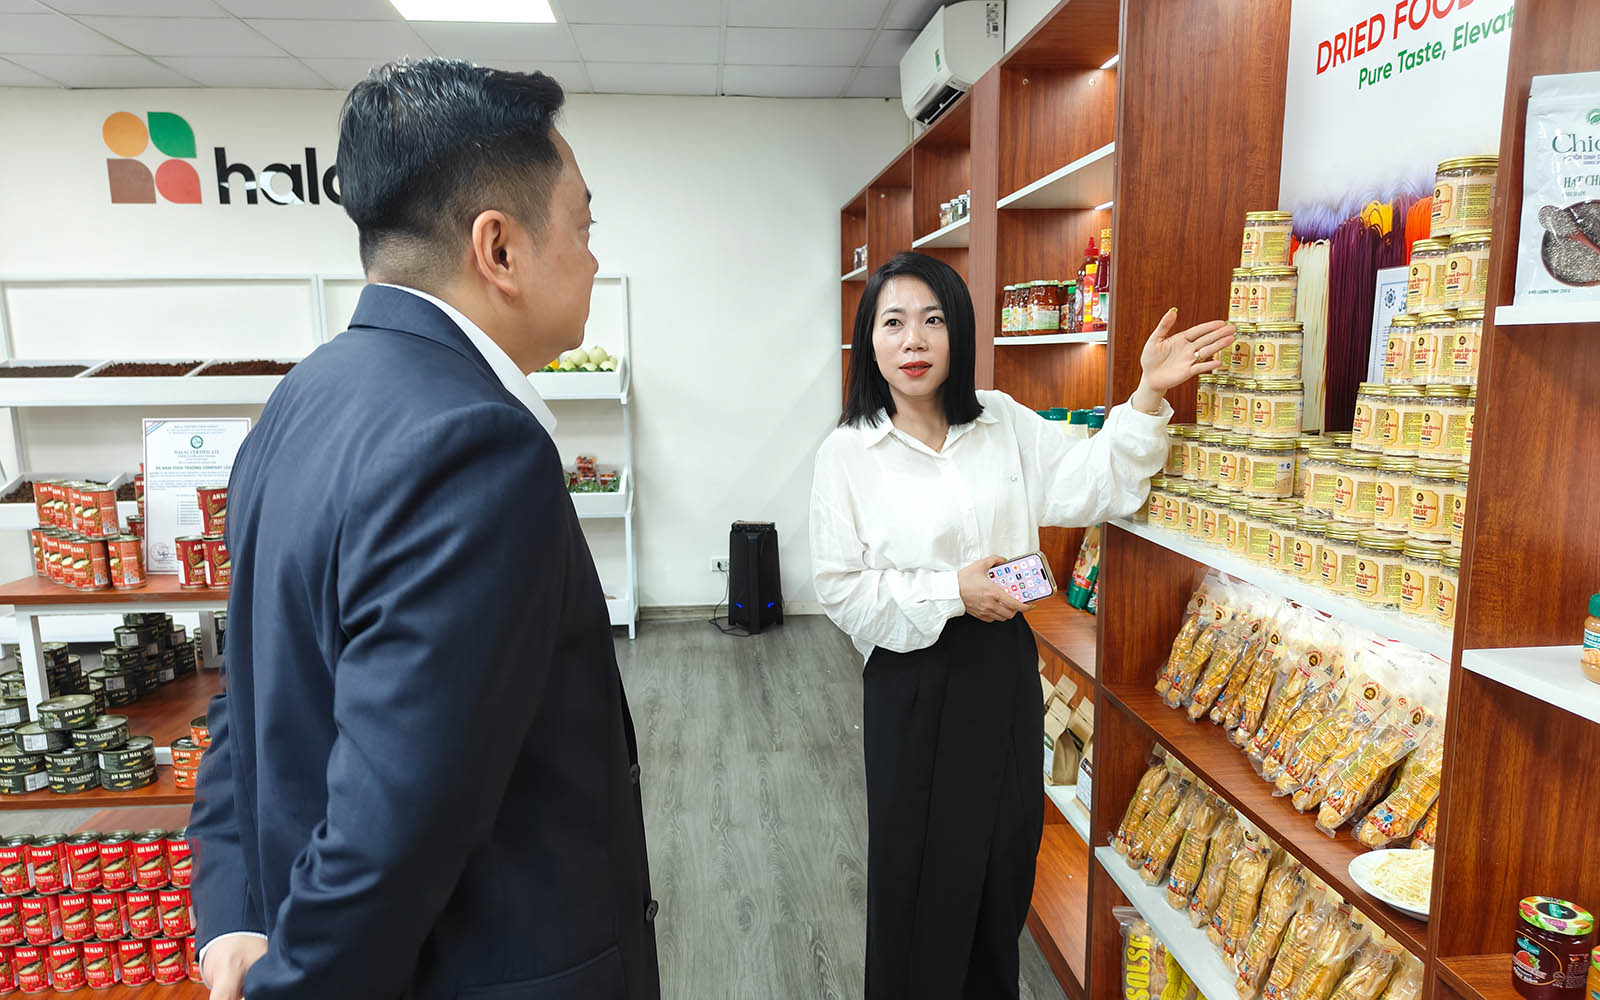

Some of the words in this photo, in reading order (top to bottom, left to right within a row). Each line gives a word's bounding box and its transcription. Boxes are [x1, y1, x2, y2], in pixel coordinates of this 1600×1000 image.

[1316, 13, 1386, 75] DRIED
[1393, 0, 1482, 40] FOO
[1358, 62, 1393, 90] Pure
[1397, 40, 1447, 73] Taste,
[1452, 5, 1515, 52] Elevat
[83, 846, 97, 854] NAM
[130, 942, 143, 950] NAM
[61, 947, 75, 955] NAM
